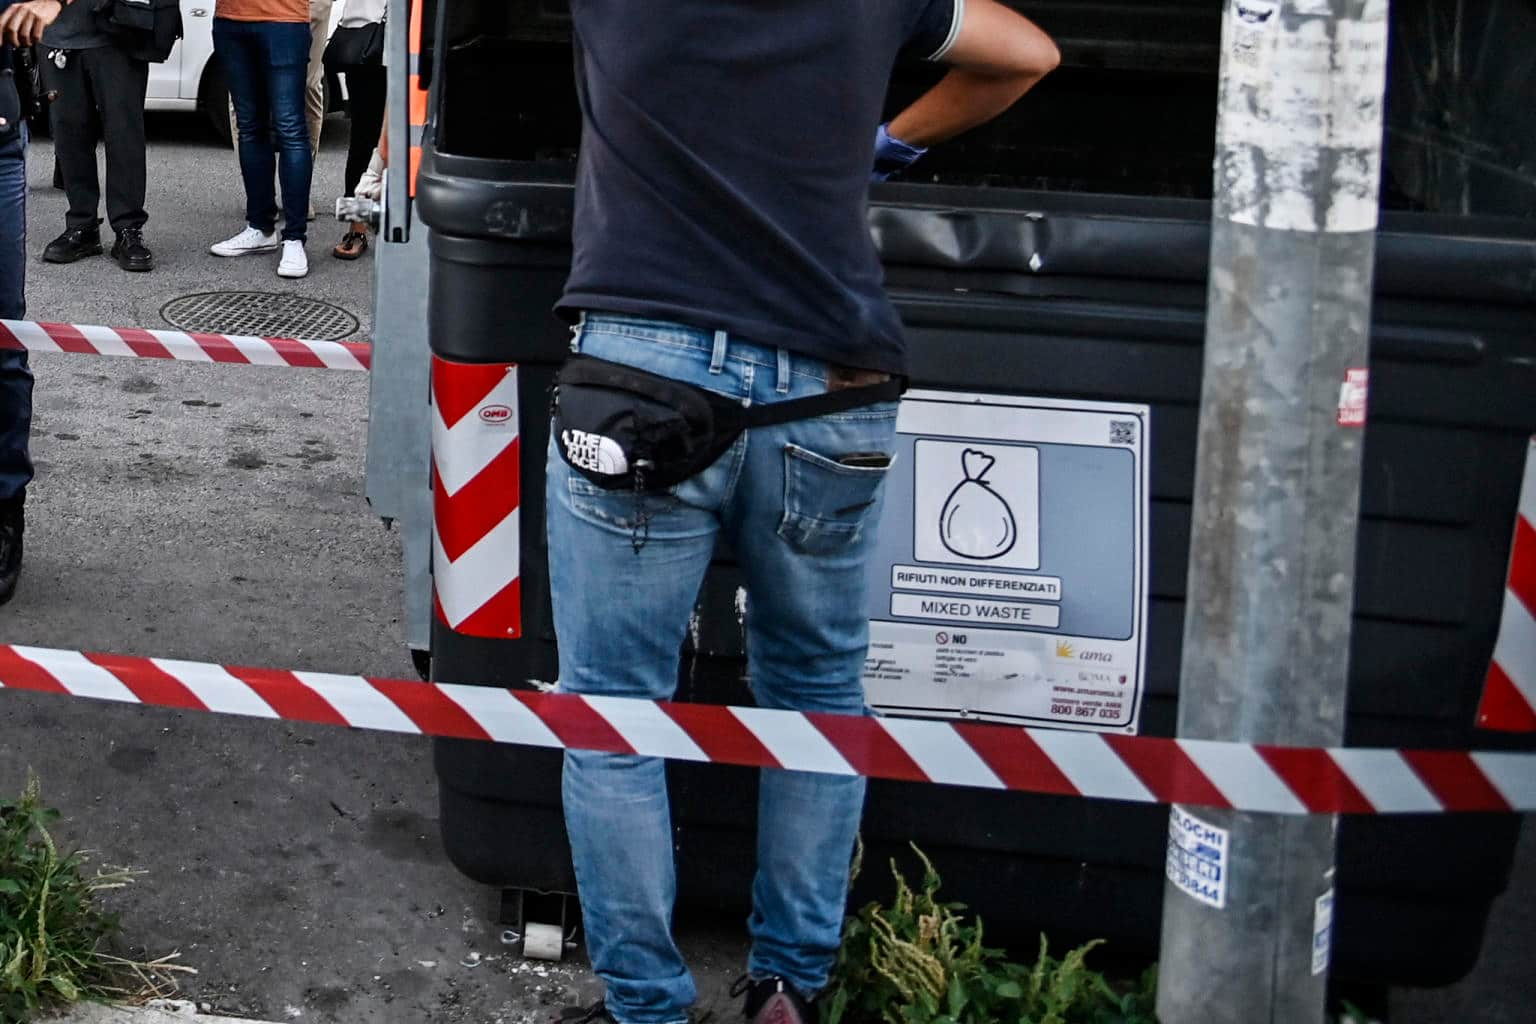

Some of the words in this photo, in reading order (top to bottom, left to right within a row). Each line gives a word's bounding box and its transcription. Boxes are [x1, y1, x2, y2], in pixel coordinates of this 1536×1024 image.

[571, 429, 601, 447] THE
[897, 572, 938, 584] RIFIUTI
[941, 576, 967, 587] NON
[969, 577, 1057, 594] DIFFERENZIATI
[921, 601, 971, 617] MIXED
[976, 605, 1032, 621] WASTE
[952, 634, 967, 645] NO
[1079, 650, 1113, 663] ama
[1050, 703, 1073, 716] 800
[1099, 708, 1121, 720] 035
